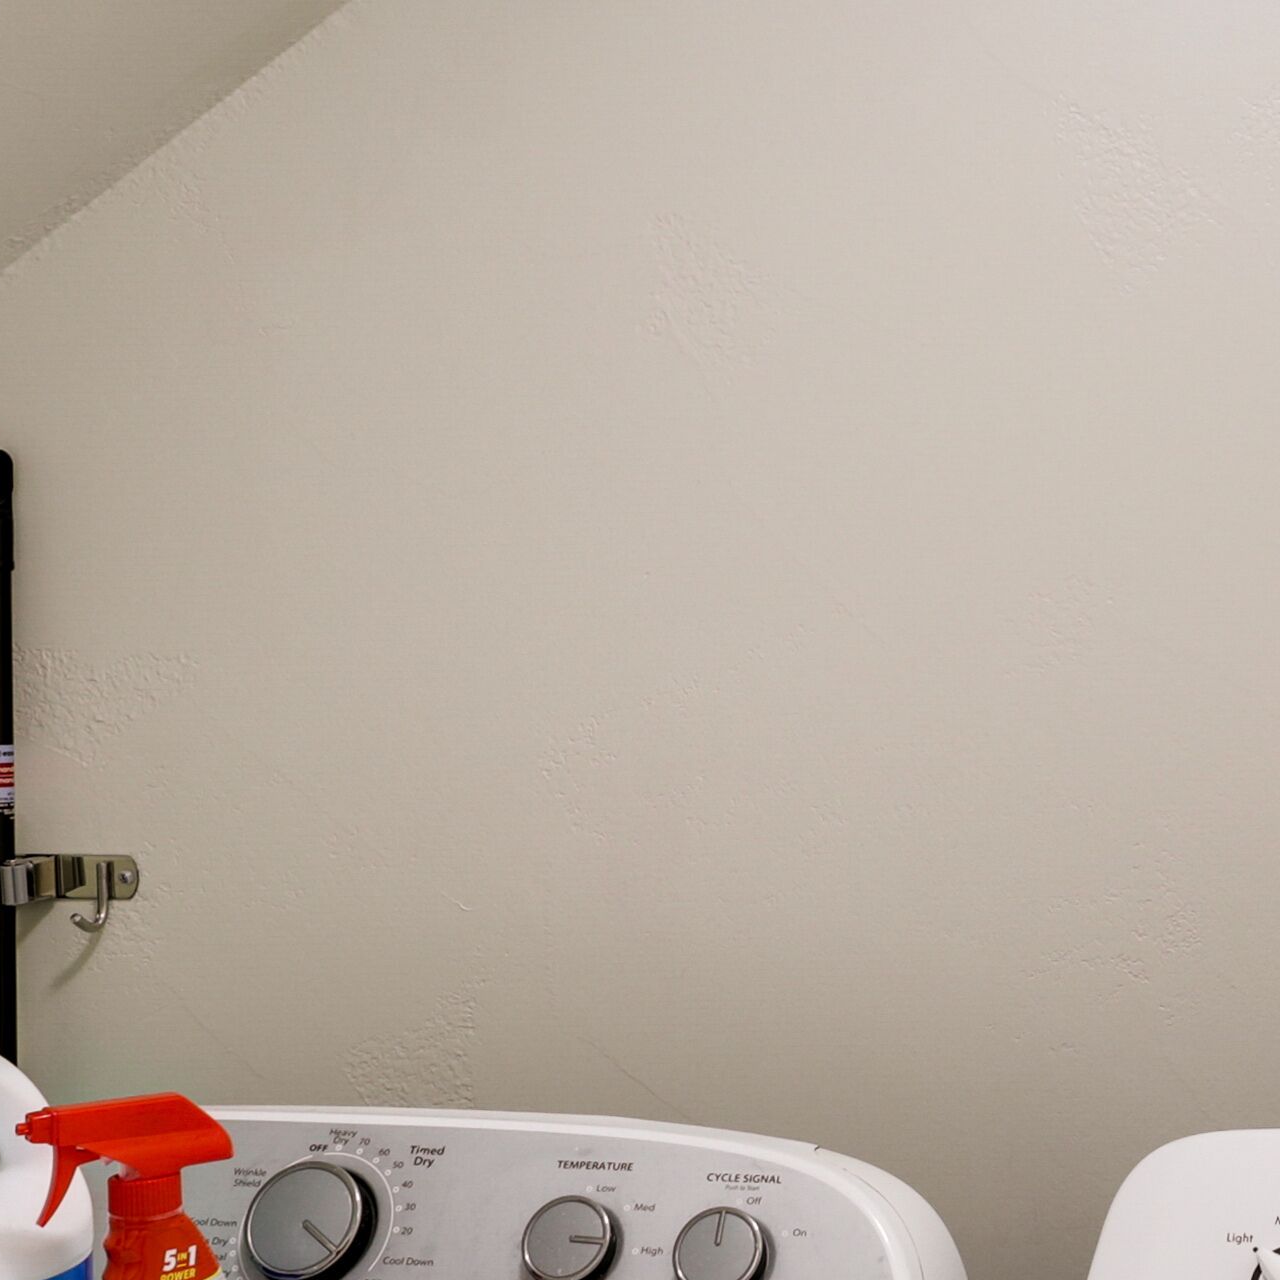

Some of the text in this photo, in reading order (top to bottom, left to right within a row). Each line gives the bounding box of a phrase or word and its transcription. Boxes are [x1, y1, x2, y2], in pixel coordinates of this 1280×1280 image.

[329, 1128, 358, 1138] Heavy
[333, 1136, 350, 1146] Dry
[360, 1137, 371, 1146] 70
[309, 1144, 328, 1152] OFF
[378, 1148, 390, 1156] 60
[410, 1144, 446, 1156] Timed
[393, 1161, 404, 1169] 50
[413, 1156, 435, 1168] Dry
[557, 1160, 633, 1172] TEMPERATURE
[233, 1167, 267, 1177] Wrinkle
[706, 1172, 782, 1184] CYCLE SIGNAL
[233, 1179, 261, 1188] Shield
[402, 1180, 413, 1188] 40
[596, 1184, 616, 1193] Low
[746, 1197, 762, 1205] Off
[405, 1203, 416, 1211] 30
[633, 1202, 655, 1212] Med
[210, 1219, 237, 1227] Down
[401, 1227, 413, 1235] 20
[792, 1228, 807, 1237] On
[211, 1237, 228, 1246] Dry
[1226, 1232, 1254, 1245] Light
[640, 1246, 663, 1257] High
[162, 1248, 178, 1272] 5
[383, 1256, 434, 1266] Cool Down
